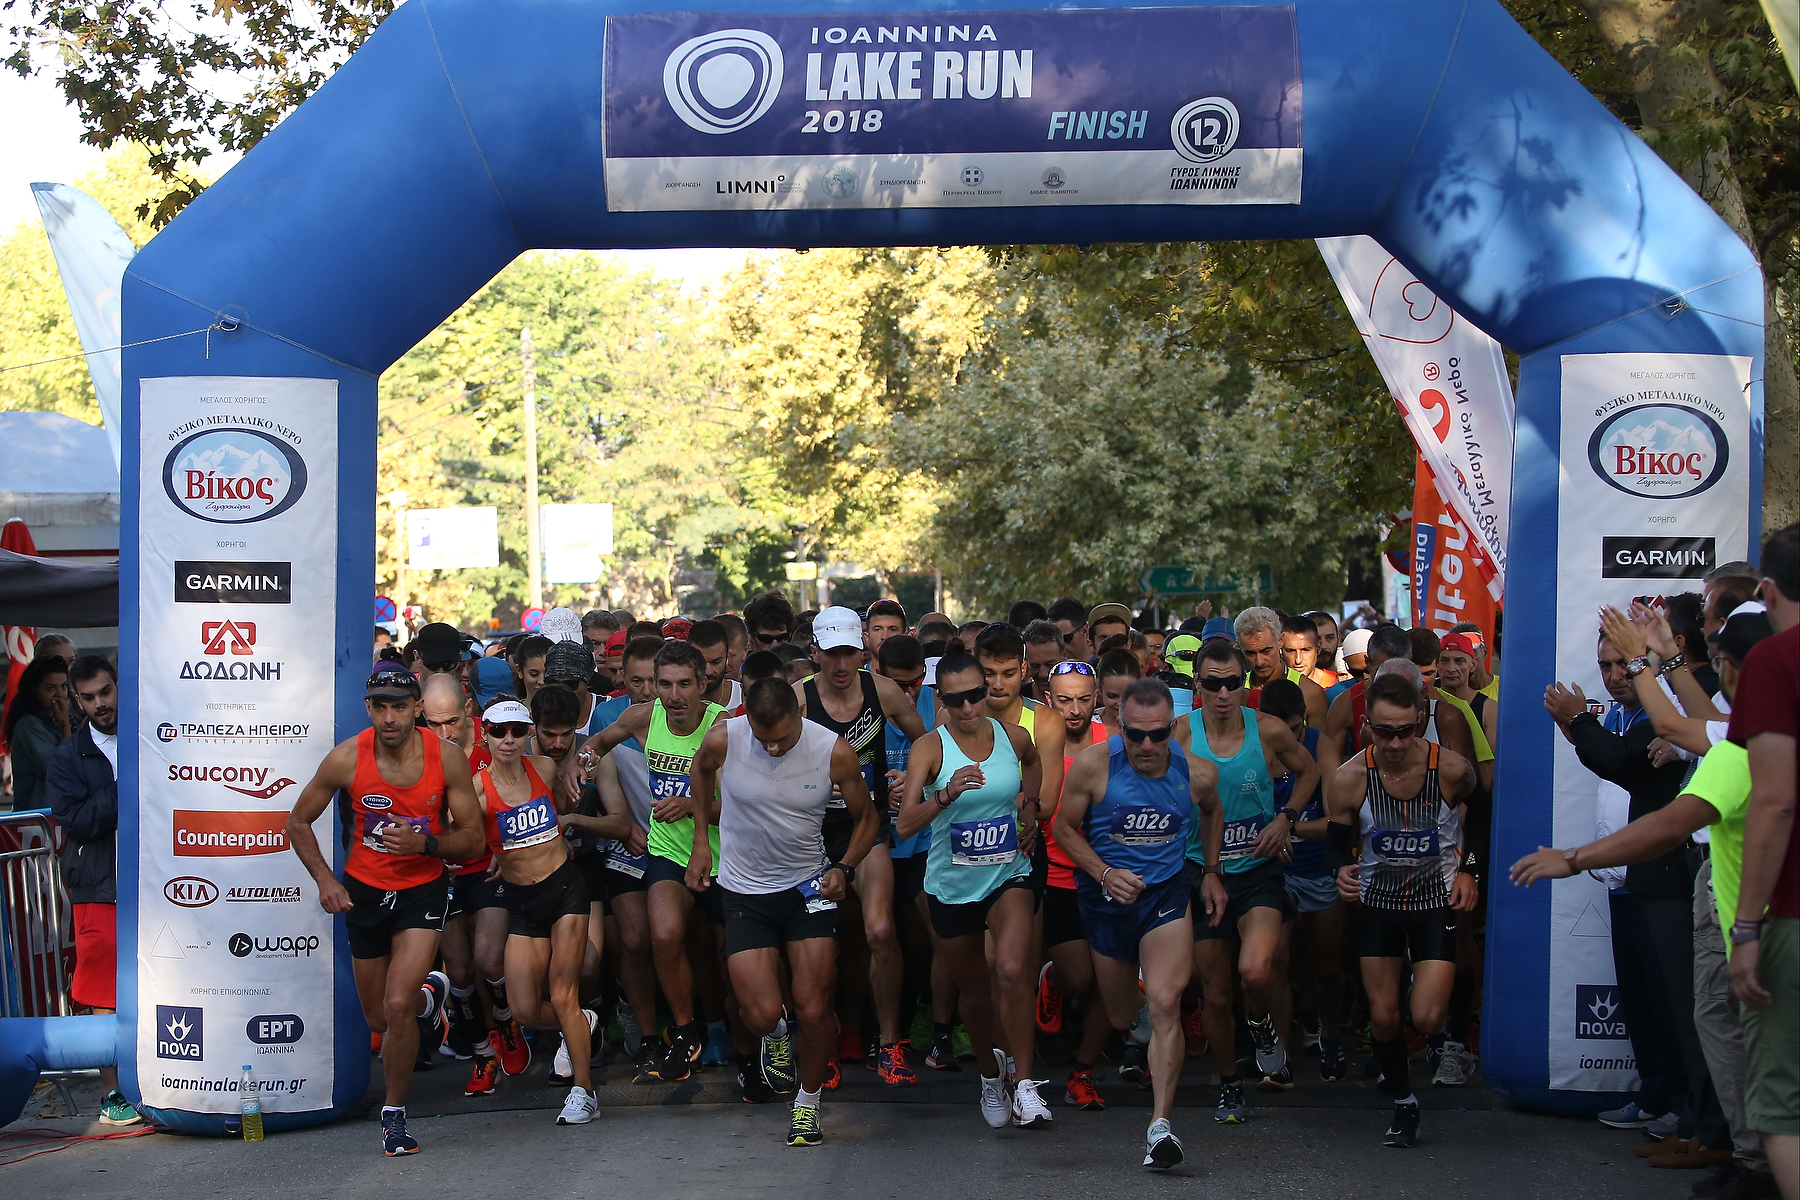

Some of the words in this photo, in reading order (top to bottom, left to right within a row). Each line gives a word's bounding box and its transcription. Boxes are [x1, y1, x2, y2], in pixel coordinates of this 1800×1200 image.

[810, 24, 998, 45] IOANNINA
[805, 51, 922, 101] LAKE
[932, 49, 1034, 100] RUN
[800, 109, 884, 134] 2018
[1047, 109, 1149, 141] FINISH
[1190, 117, 1221, 146] 12
[1170, 167, 1200, 177] ΓΥΡΟΣ
[1201, 166, 1241, 177] ΛΙΜΝΗΣ
[1170, 178, 1238, 190] ΙΩΑΝΝΙΝΩΝ
[1665, 372, 1696, 380] ΧΟΡΗΓΟΣ
[200, 396, 233, 404] ΜΕΓΑΛΟΣ
[234, 396, 267, 404] ΧΟΡΗΓΟΣ
[1594, 393, 1635, 418] ΦΥΣΙΚΟ
[1637, 390, 1701, 405] ΜΕΤΑΛΛΙΚΟ
[1702, 399, 1726, 421] ΝΕΡΟ
[168, 418, 205, 442] ΦΥΣΙΚΟ
[206, 415, 273, 431] ΜΕΤΑΛΛΙΚΟ
[276, 424, 302, 445] ΝΕΡΟ
[1614, 445, 1703, 481] Βίκος
[184, 470, 274, 506] Βίκος
[1647, 516, 1677, 524] ΧΟΡΗΓΟΙ
[1615, 550, 1706, 566] GARMIN
[186, 574, 280, 591] GARMIN
[179, 661, 281, 681] ΔΩΔΩΝΗ
[179, 723, 245, 736] ΤΡΑΠΕΖΑ
[249, 724, 310, 736] ΗΠΕΙΡΟΥ
[168, 764, 269, 786] saucony
[506, 804, 549, 835] 3002
[1123, 813, 1172, 830] 3026
[177, 829, 284, 850] Counterpain
[960, 823, 1009, 848] 3007
[1223, 822, 1259, 844] 004
[1380, 835, 1431, 853] 3005
[173, 883, 210, 901] KIA
[226, 886, 301, 898] AUTOLINEA
[254, 935, 320, 958] wapp
[190, 987, 219, 995] ΧΟΡΗΓΟΙ
[220, 988, 271, 996] ΕΠΙΚΟΙΝΩΝΙΑΣ
[258, 1020, 295, 1038] ΕΡΤ
[1579, 1021, 1626, 1036] nova
[159, 1041, 200, 1057] nova
[256, 1046, 295, 1054] ΙΩΑΝΝΙΝΑ
[1579, 1054, 1638, 1070] ioannin
